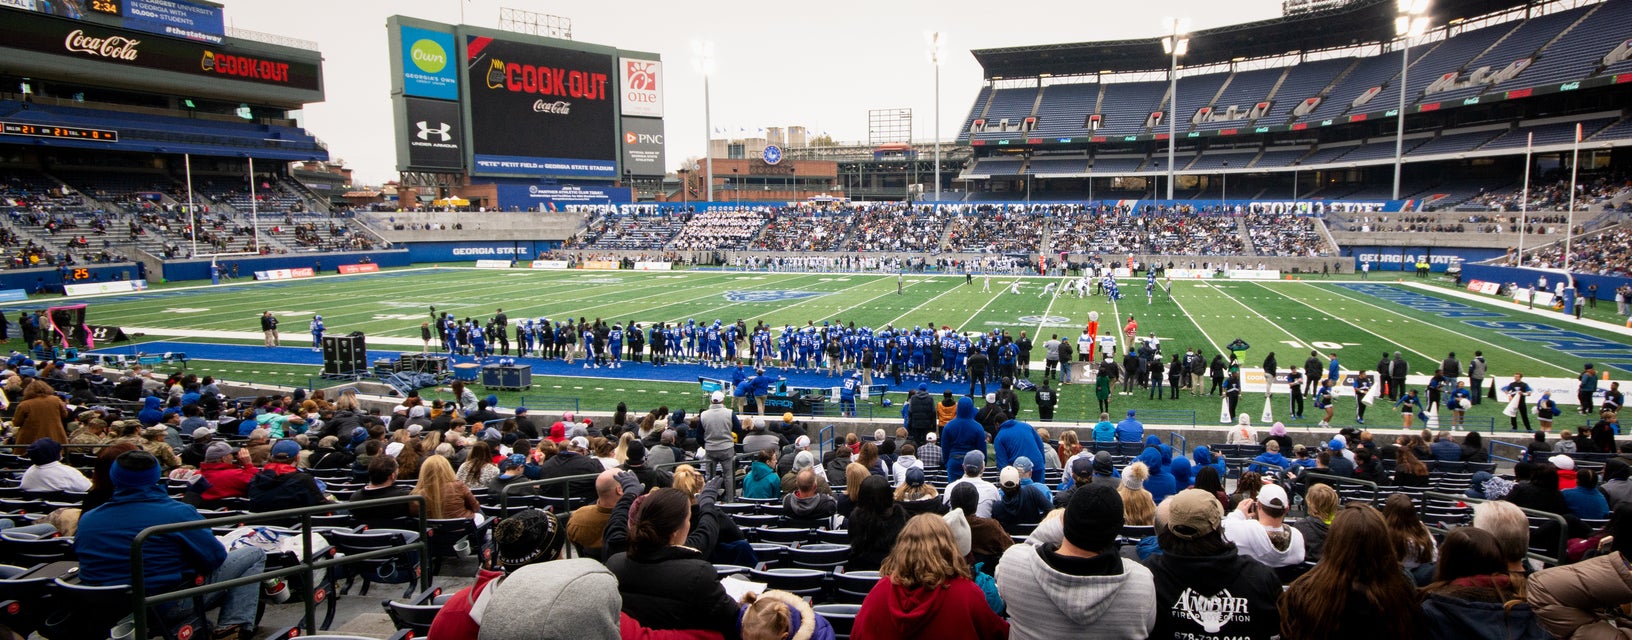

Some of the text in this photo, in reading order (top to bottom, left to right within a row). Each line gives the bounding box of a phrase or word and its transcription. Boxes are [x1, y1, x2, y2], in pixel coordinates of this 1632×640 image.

[92, 1, 117, 13] 2:34
[139, 2, 168, 13] GEORGIA
[169, 7, 187, 17] WITH
[177, 2, 213, 16] UNIVERSITY
[160, 13, 194, 25] STUDENTS
[165, 26, 222, 43] #thestateway
[413, 48, 444, 64] Own
[404, 72, 439, 82] GEORGIA'S
[627, 91, 657, 103] one
[638, 133, 663, 144] PNC
[453, 247, 528, 255] GEORGIA STATE
[1359, 253, 1458, 264] GEORGIA STATE
[74, 268, 89, 279] 25
